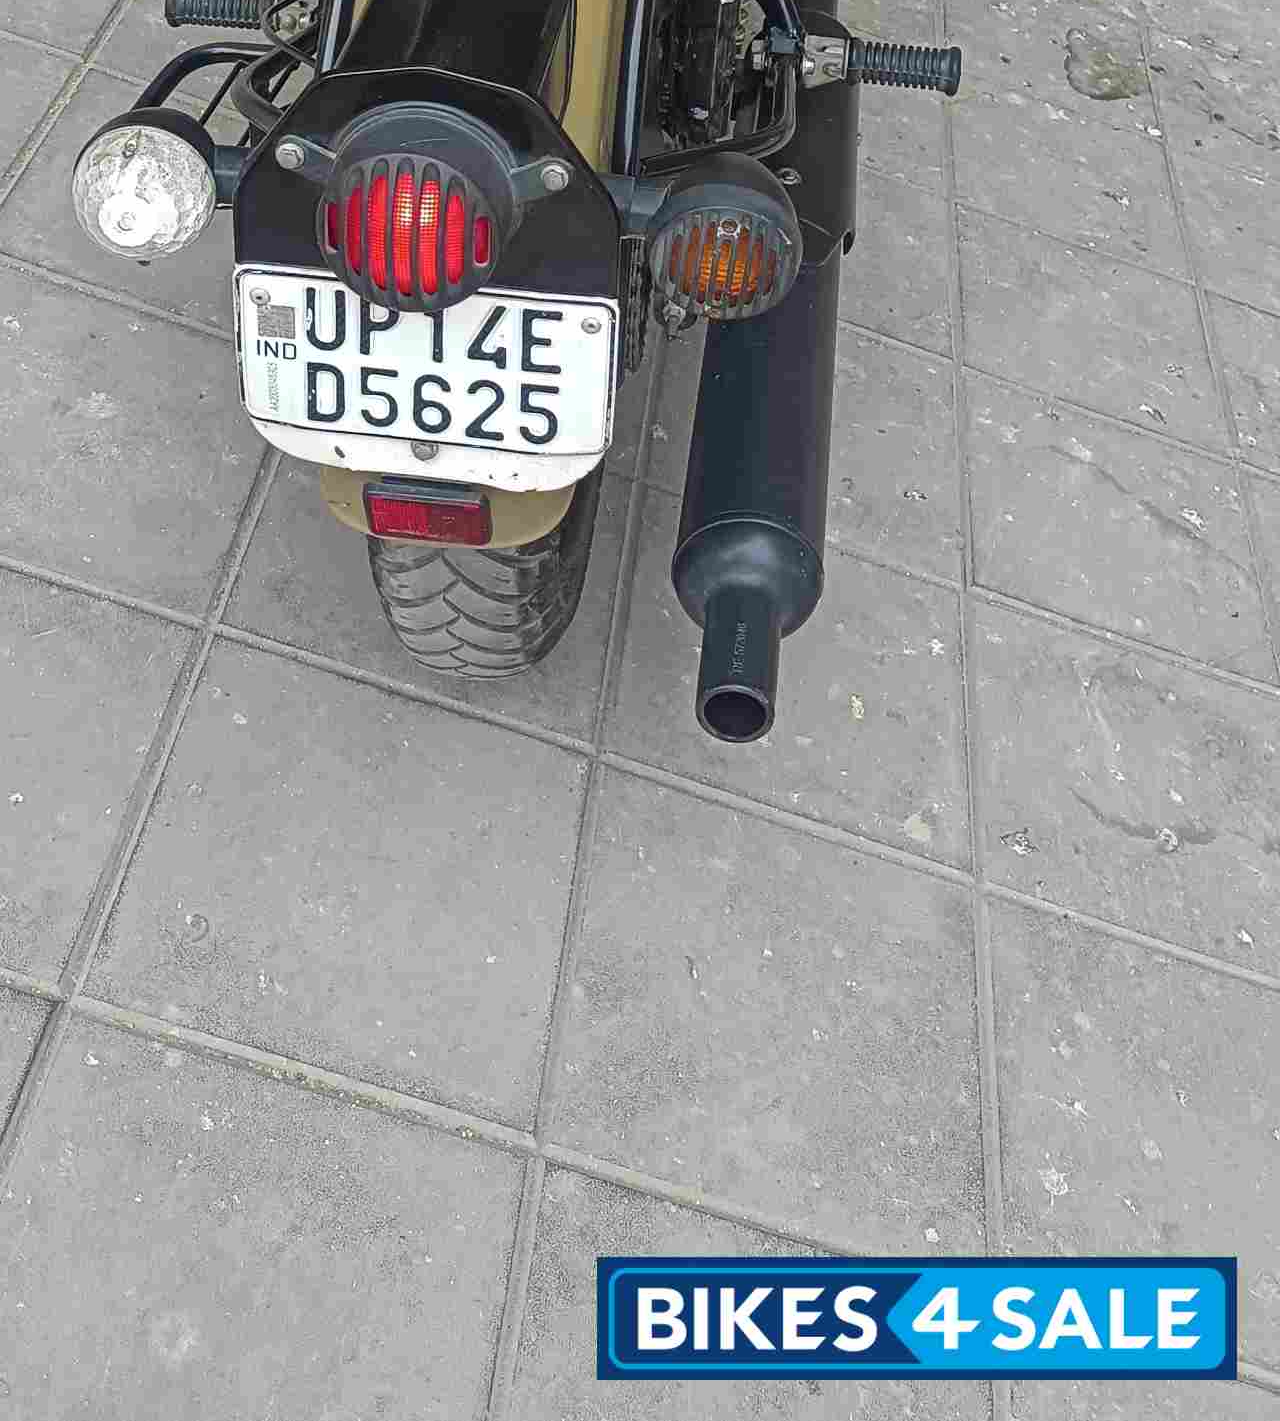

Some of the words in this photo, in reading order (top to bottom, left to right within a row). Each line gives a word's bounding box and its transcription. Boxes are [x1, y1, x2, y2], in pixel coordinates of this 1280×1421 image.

[256, 339, 297, 360] IND
[306, 286, 564, 375] UP14E
[306, 361, 559, 445] D5625
